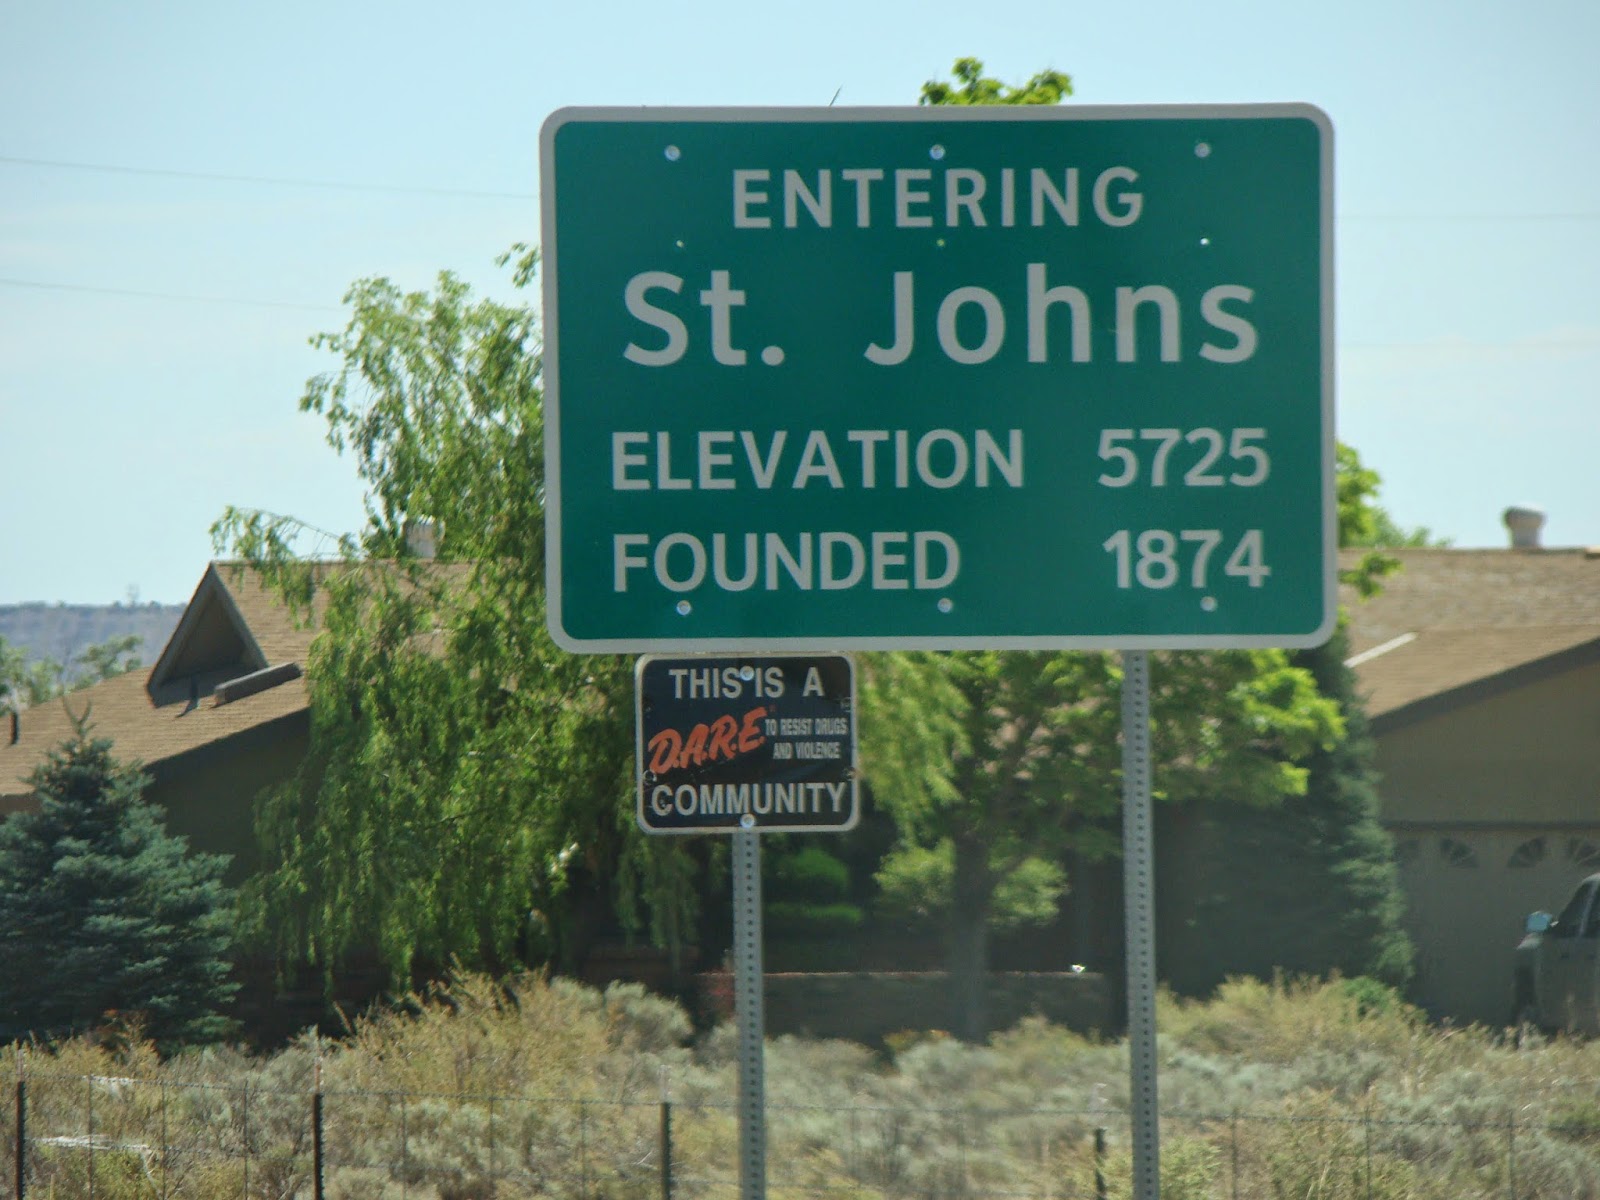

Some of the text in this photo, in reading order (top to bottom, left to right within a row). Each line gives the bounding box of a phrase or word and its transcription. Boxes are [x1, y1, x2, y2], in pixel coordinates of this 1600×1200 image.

[733, 166, 1144, 229] ENTERING
[623, 262, 1259, 367] St. Johns
[612, 427, 1271, 491] ELEVATION 5725
[613, 528, 1272, 593] FOUNDED 1874
[668, 666, 825, 699] THIS IS A
[764, 717, 848, 736] TO RESIST DRUGS
[773, 741, 841, 760] AND VIOLENCE
[651, 782, 848, 816] COMMUNITY
